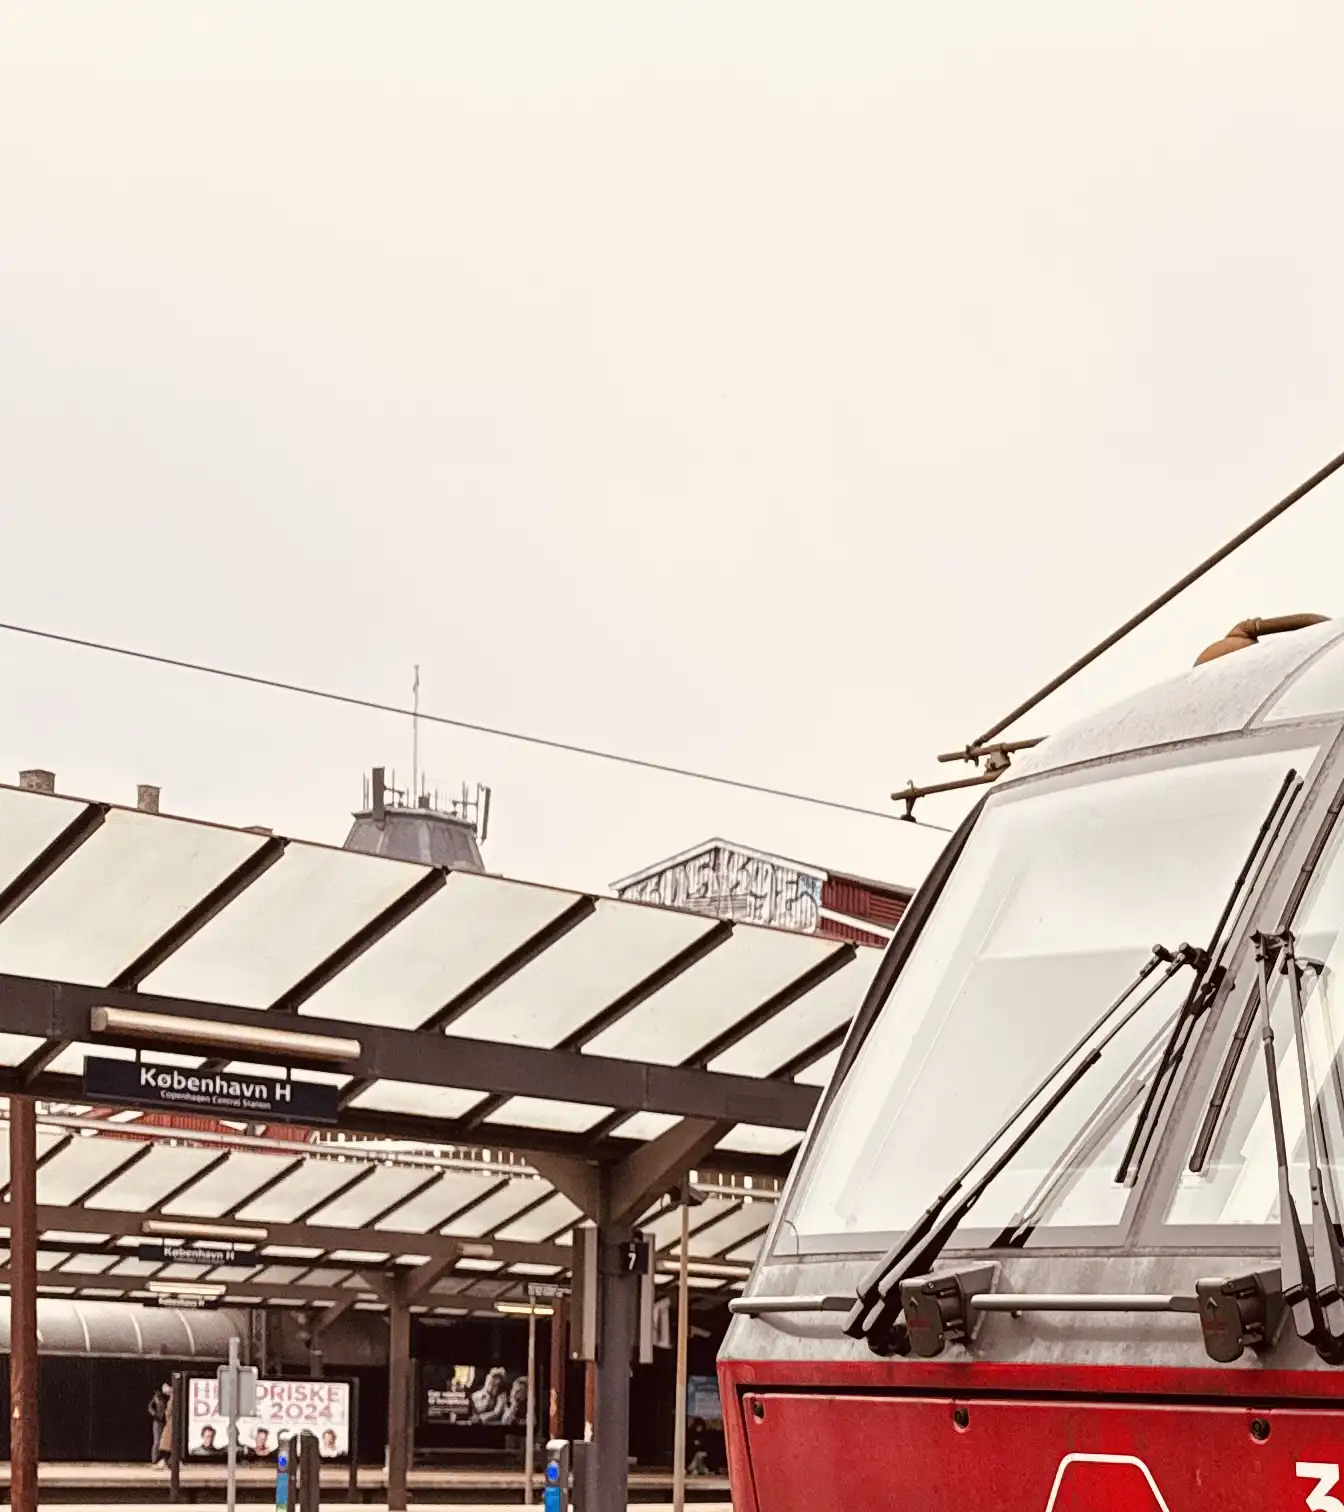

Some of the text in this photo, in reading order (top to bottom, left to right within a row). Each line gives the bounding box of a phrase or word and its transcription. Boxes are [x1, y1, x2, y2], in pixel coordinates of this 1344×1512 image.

[140, 1067, 291, 1102] København H
[160, 1089, 271, 1110] Copenhagen Central Station
[163, 1247, 224, 1260] København
[226, 1250, 235, 1261] H
[628, 1252, 637, 1271] 7
[193, 1381, 339, 1402] HIORISKE
[271, 1402, 333, 1420] 2024
